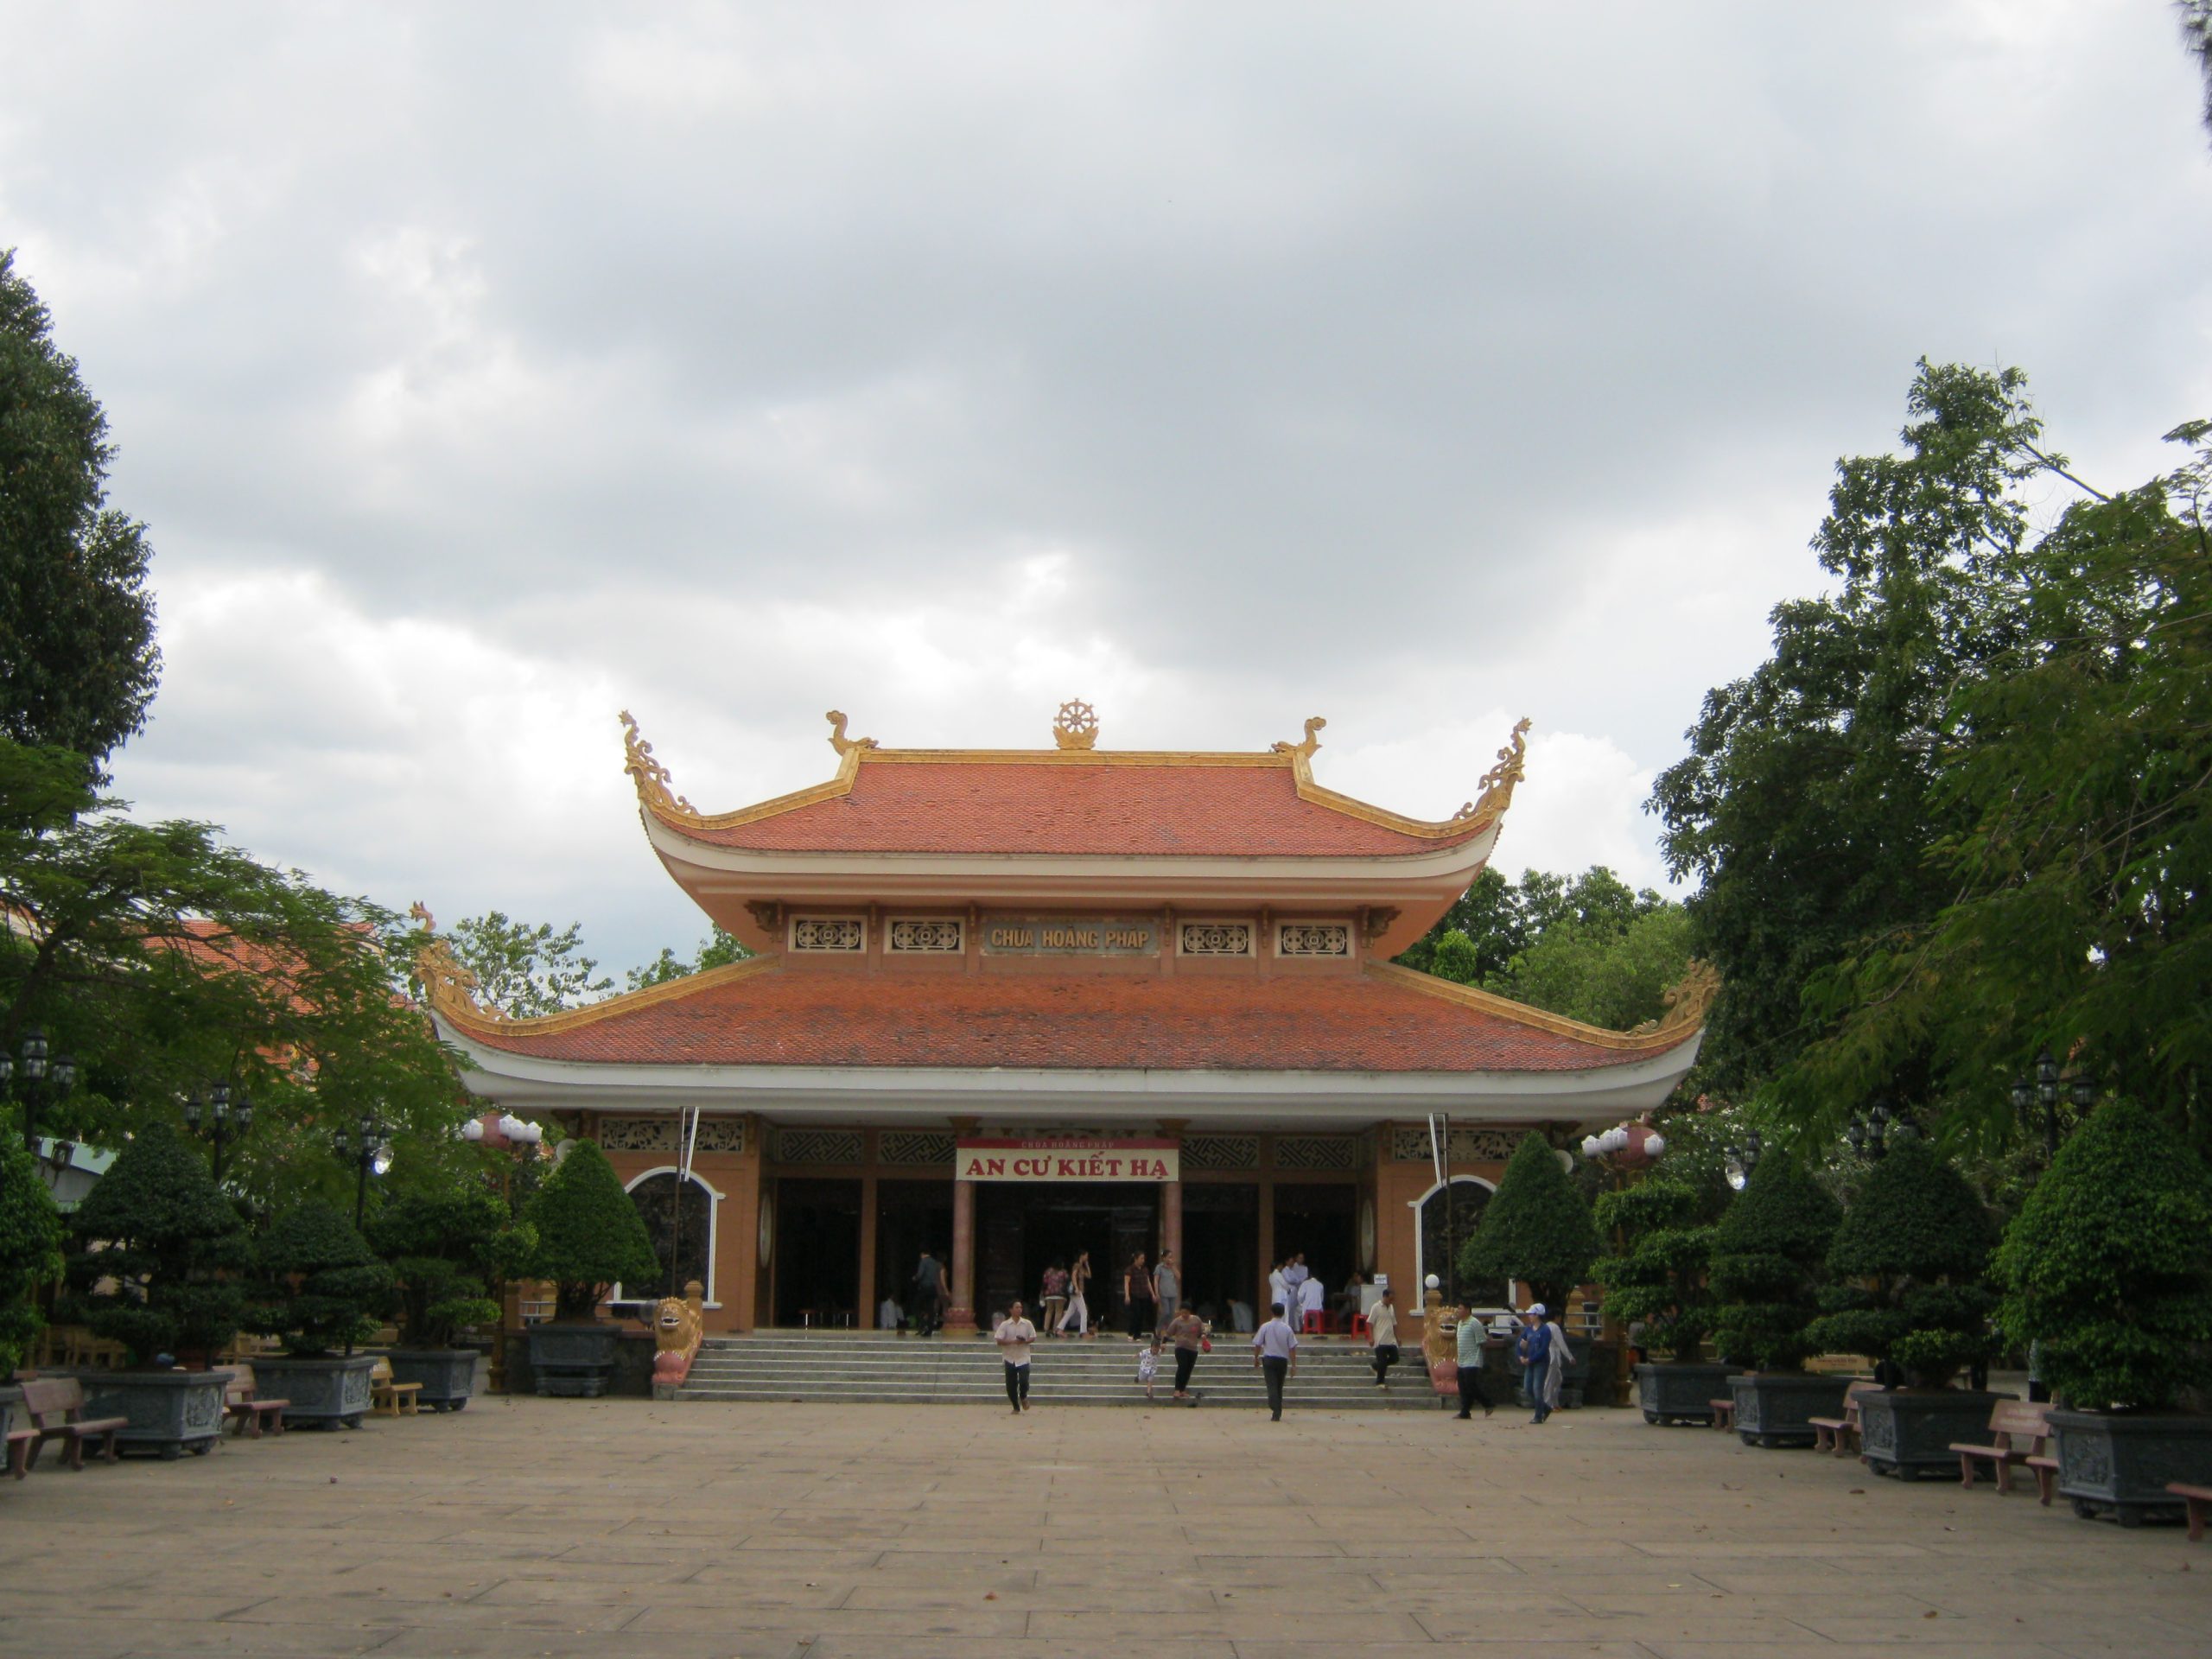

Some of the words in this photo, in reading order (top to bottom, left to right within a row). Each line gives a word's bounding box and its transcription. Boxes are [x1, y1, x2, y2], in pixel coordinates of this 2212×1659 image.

[1105, 926, 1149, 949] PHÁP
[966, 1158, 1006, 1176] AN
[1013, 1155, 1052, 1176] CƯ
[1057, 1150, 1122, 1176] KIẾT
[1129, 1159, 1169, 1179] HẠ
